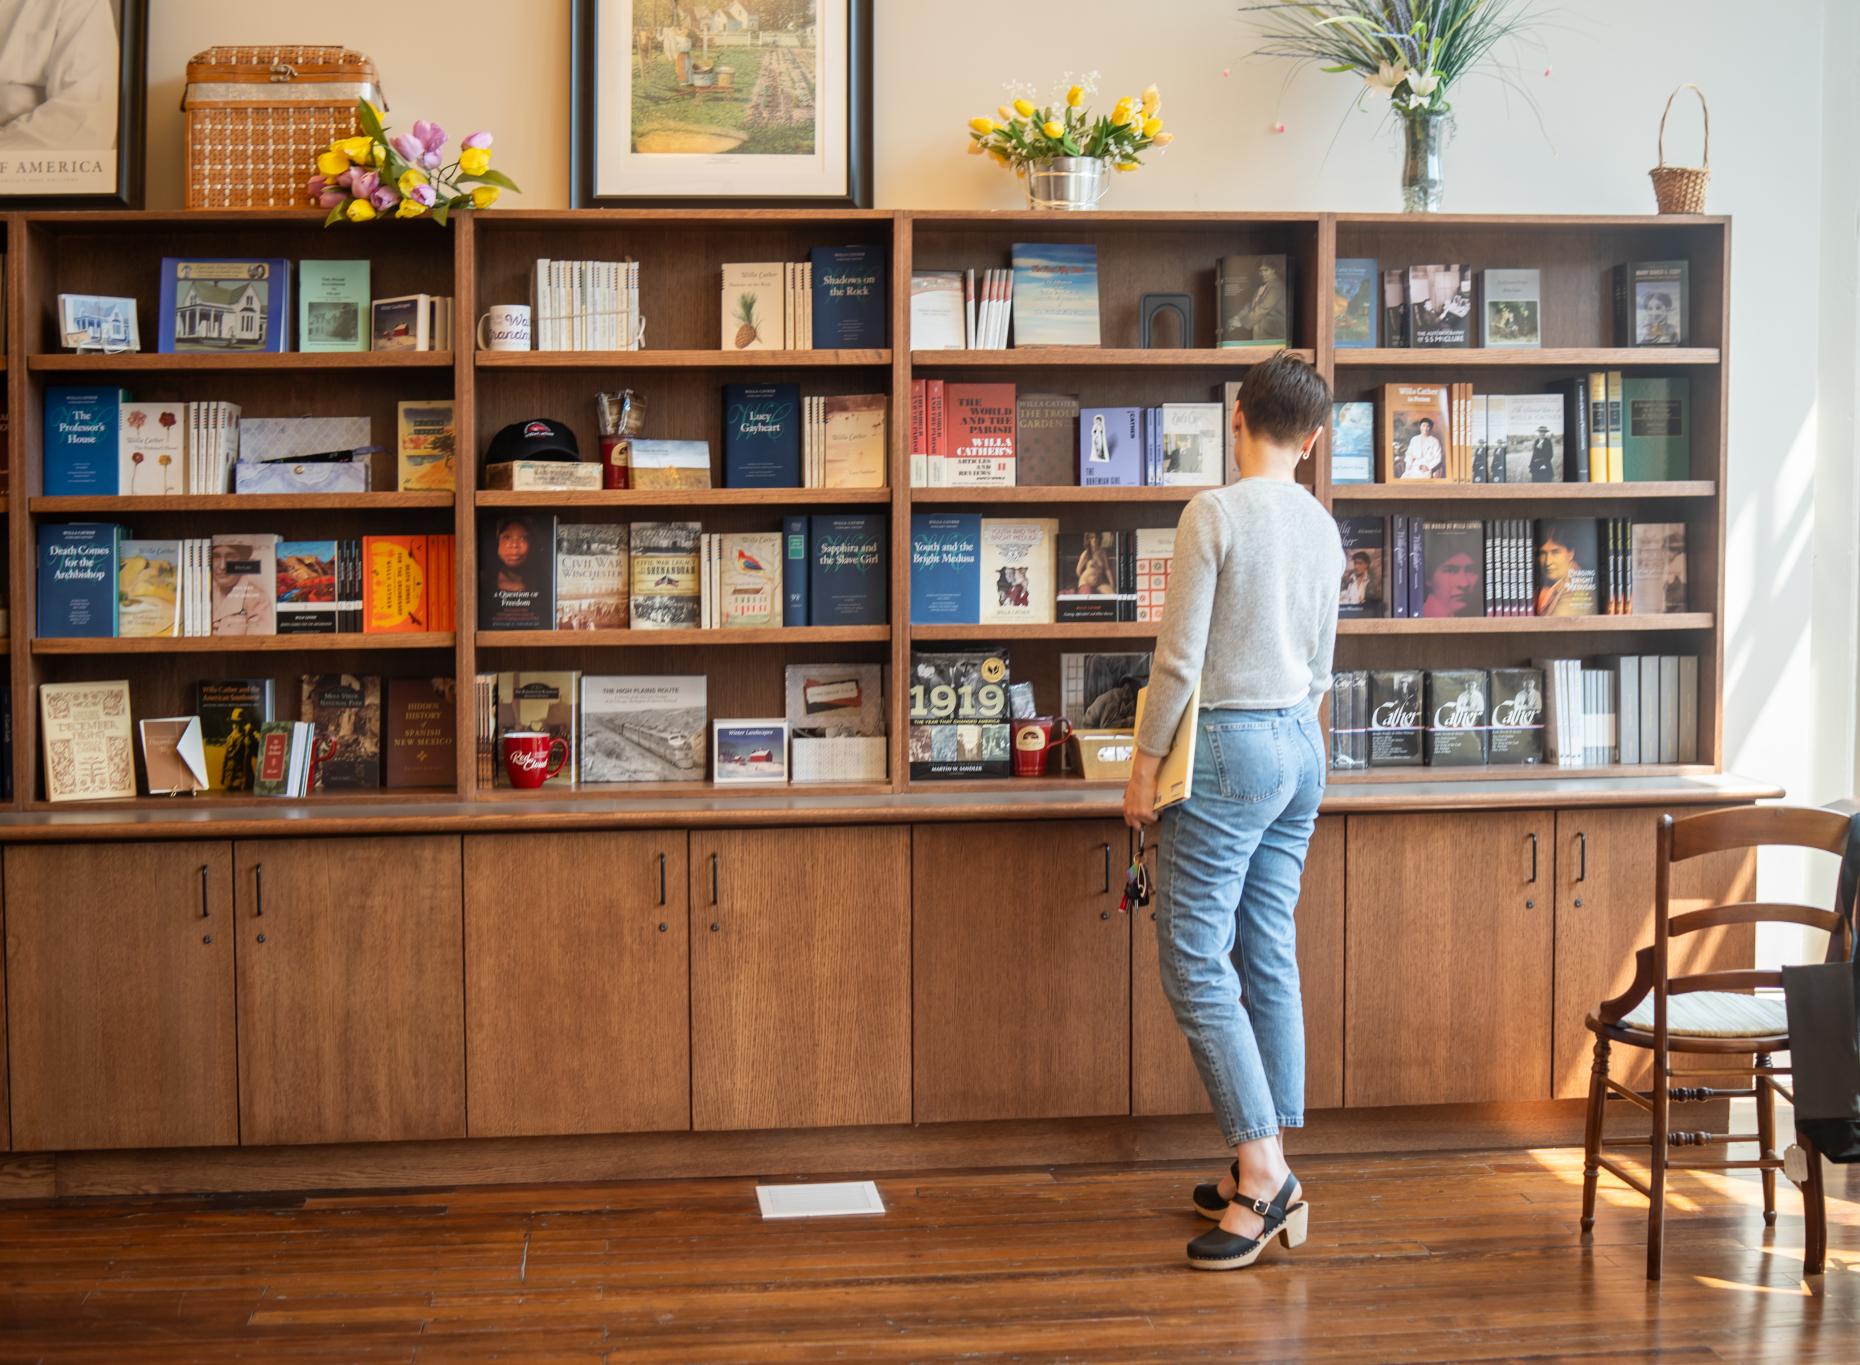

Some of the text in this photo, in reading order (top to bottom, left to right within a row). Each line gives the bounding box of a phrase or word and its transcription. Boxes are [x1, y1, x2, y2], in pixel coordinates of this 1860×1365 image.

[16, 160, 103, 173] AMERICA
[823, 275, 876, 286] Shadows on
[830, 286, 870, 297] the Rock
[959, 399, 982, 407] THE
[72, 411, 92, 421] The
[750, 411, 772, 422] Lucy
[1020, 409, 1042, 418] THE
[961, 417, 1012, 425] AND THE
[1019, 419, 1063, 428] GARDEN
[59, 422, 105, 432] Professor's
[740, 422, 781, 435] Gayheart
[969, 426, 1012, 434] PARISH
[67, 433, 97, 444] House
[971, 437, 1013, 447] WILLA
[956, 447, 1013, 457] CATHER'S
[50, 545, 110, 555] Death Comes
[820, 543, 877, 555] Sapphira and
[914, 542, 974, 552] Youth and the
[64, 558, 94, 568] for the
[562, 557, 623, 569] CIVIL WAR
[820, 554, 879, 565] the Slave Girl
[913, 553, 975, 565] Bright Medusa
[54, 569, 105, 581] Archbishop
[562, 569, 623, 580] WINCHESTER
[910, 684, 1005, 718] 1919
[408, 703, 440, 711] HIDDEN
[1372, 695, 1420, 729] Cather
[405, 712, 441, 720] HISTORY
[1434, 702, 1483, 729] Cather
[1492, 700, 1540, 729] Cather
[404, 729, 441, 737] SPANISH
[745, 729, 774, 738] Landscapes
[394, 737, 453, 746] NEW MEXICO
[510, 750, 530, 765] Red
[523, 757, 548, 771] Cloud
